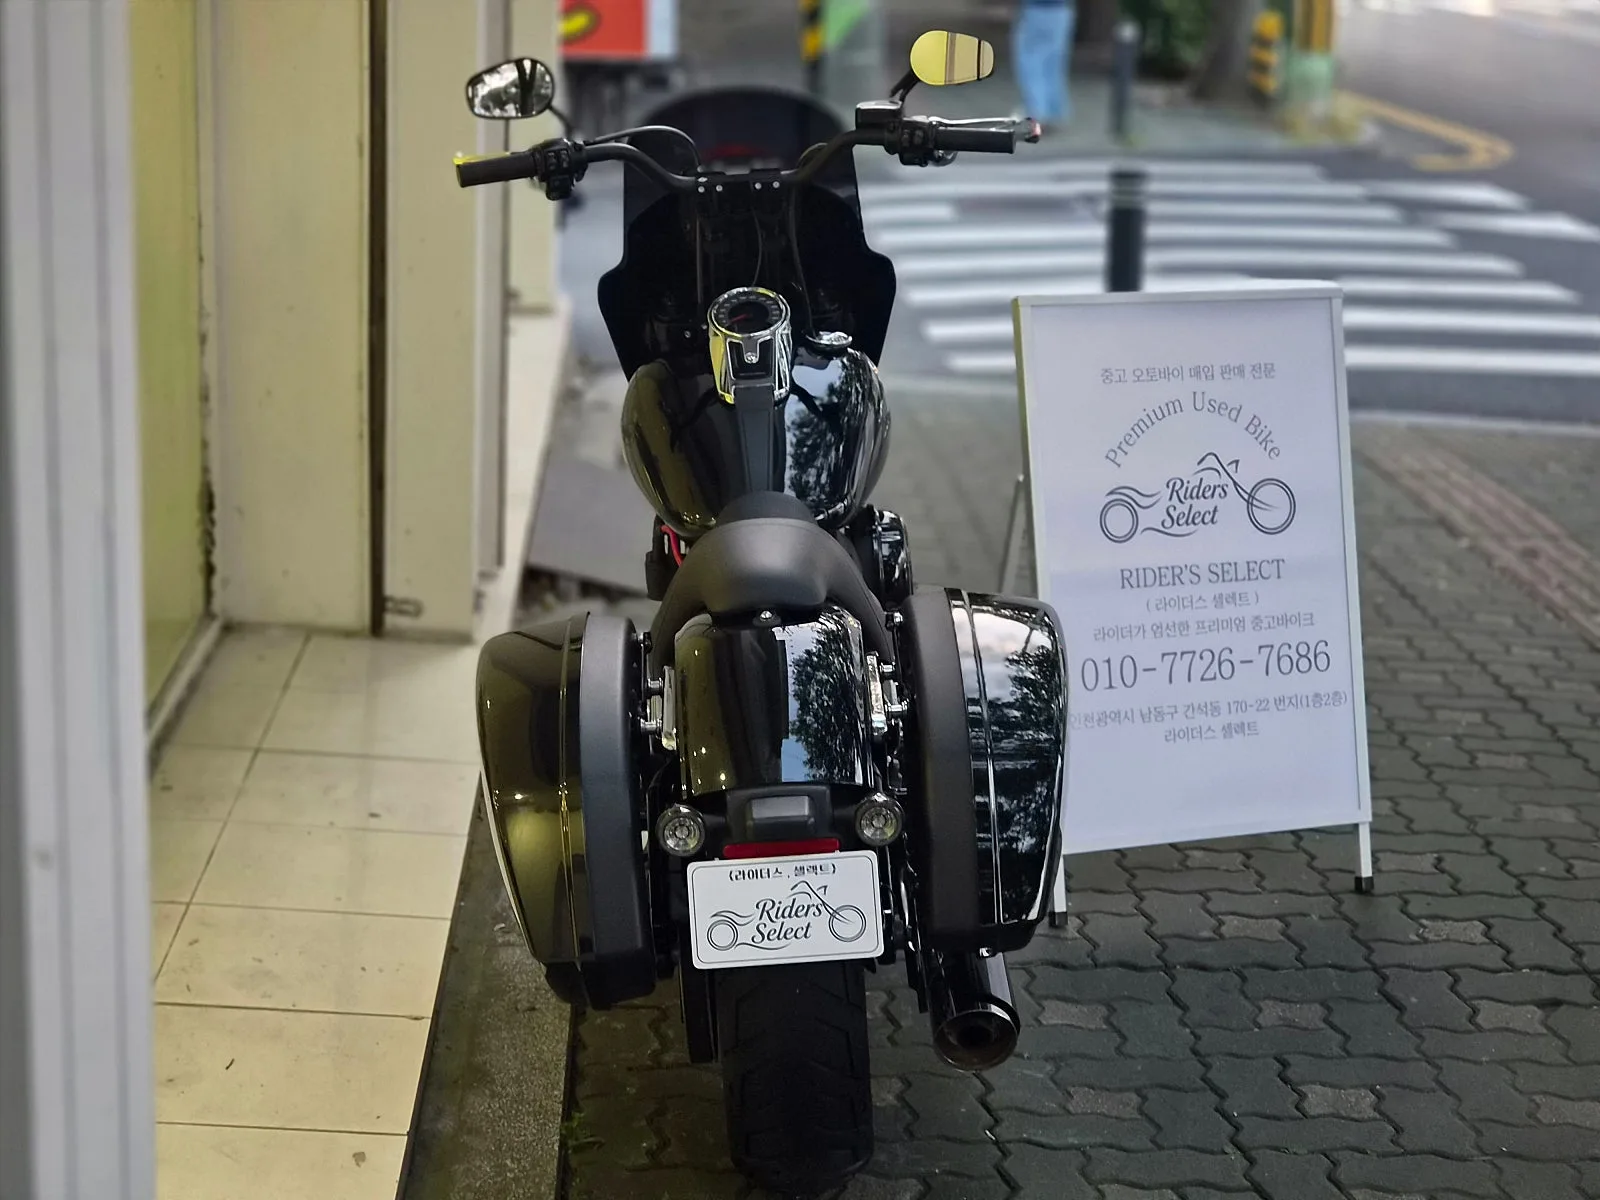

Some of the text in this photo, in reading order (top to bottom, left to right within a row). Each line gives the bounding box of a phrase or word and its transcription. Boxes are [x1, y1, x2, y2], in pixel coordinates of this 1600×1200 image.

[1101, 362, 1276, 385] 중고 오토바이 매입 판매 전문
[1105, 391, 1281, 468] Premium Used Bike
[1166, 476, 1229, 504] Riders
[1161, 504, 1218, 529] Select
[1120, 558, 1286, 590] RIDER'S SELECT
[1093, 623, 1147, 643] 라이더가
[1195, 616, 1247, 636] 프리미엄
[1251, 612, 1316, 632] 중고바이크
[1080, 639, 1332, 693] 010-7726-7686
[1140, 704, 1178, 724] 남동구
[1183, 701, 1222, 719] 간석동
[1227, 698, 1270, 715] 170-22
[1164, 725, 1217, 744] 라이더스
[756, 898, 823, 923] Riders
[751, 922, 812, 945] Select
